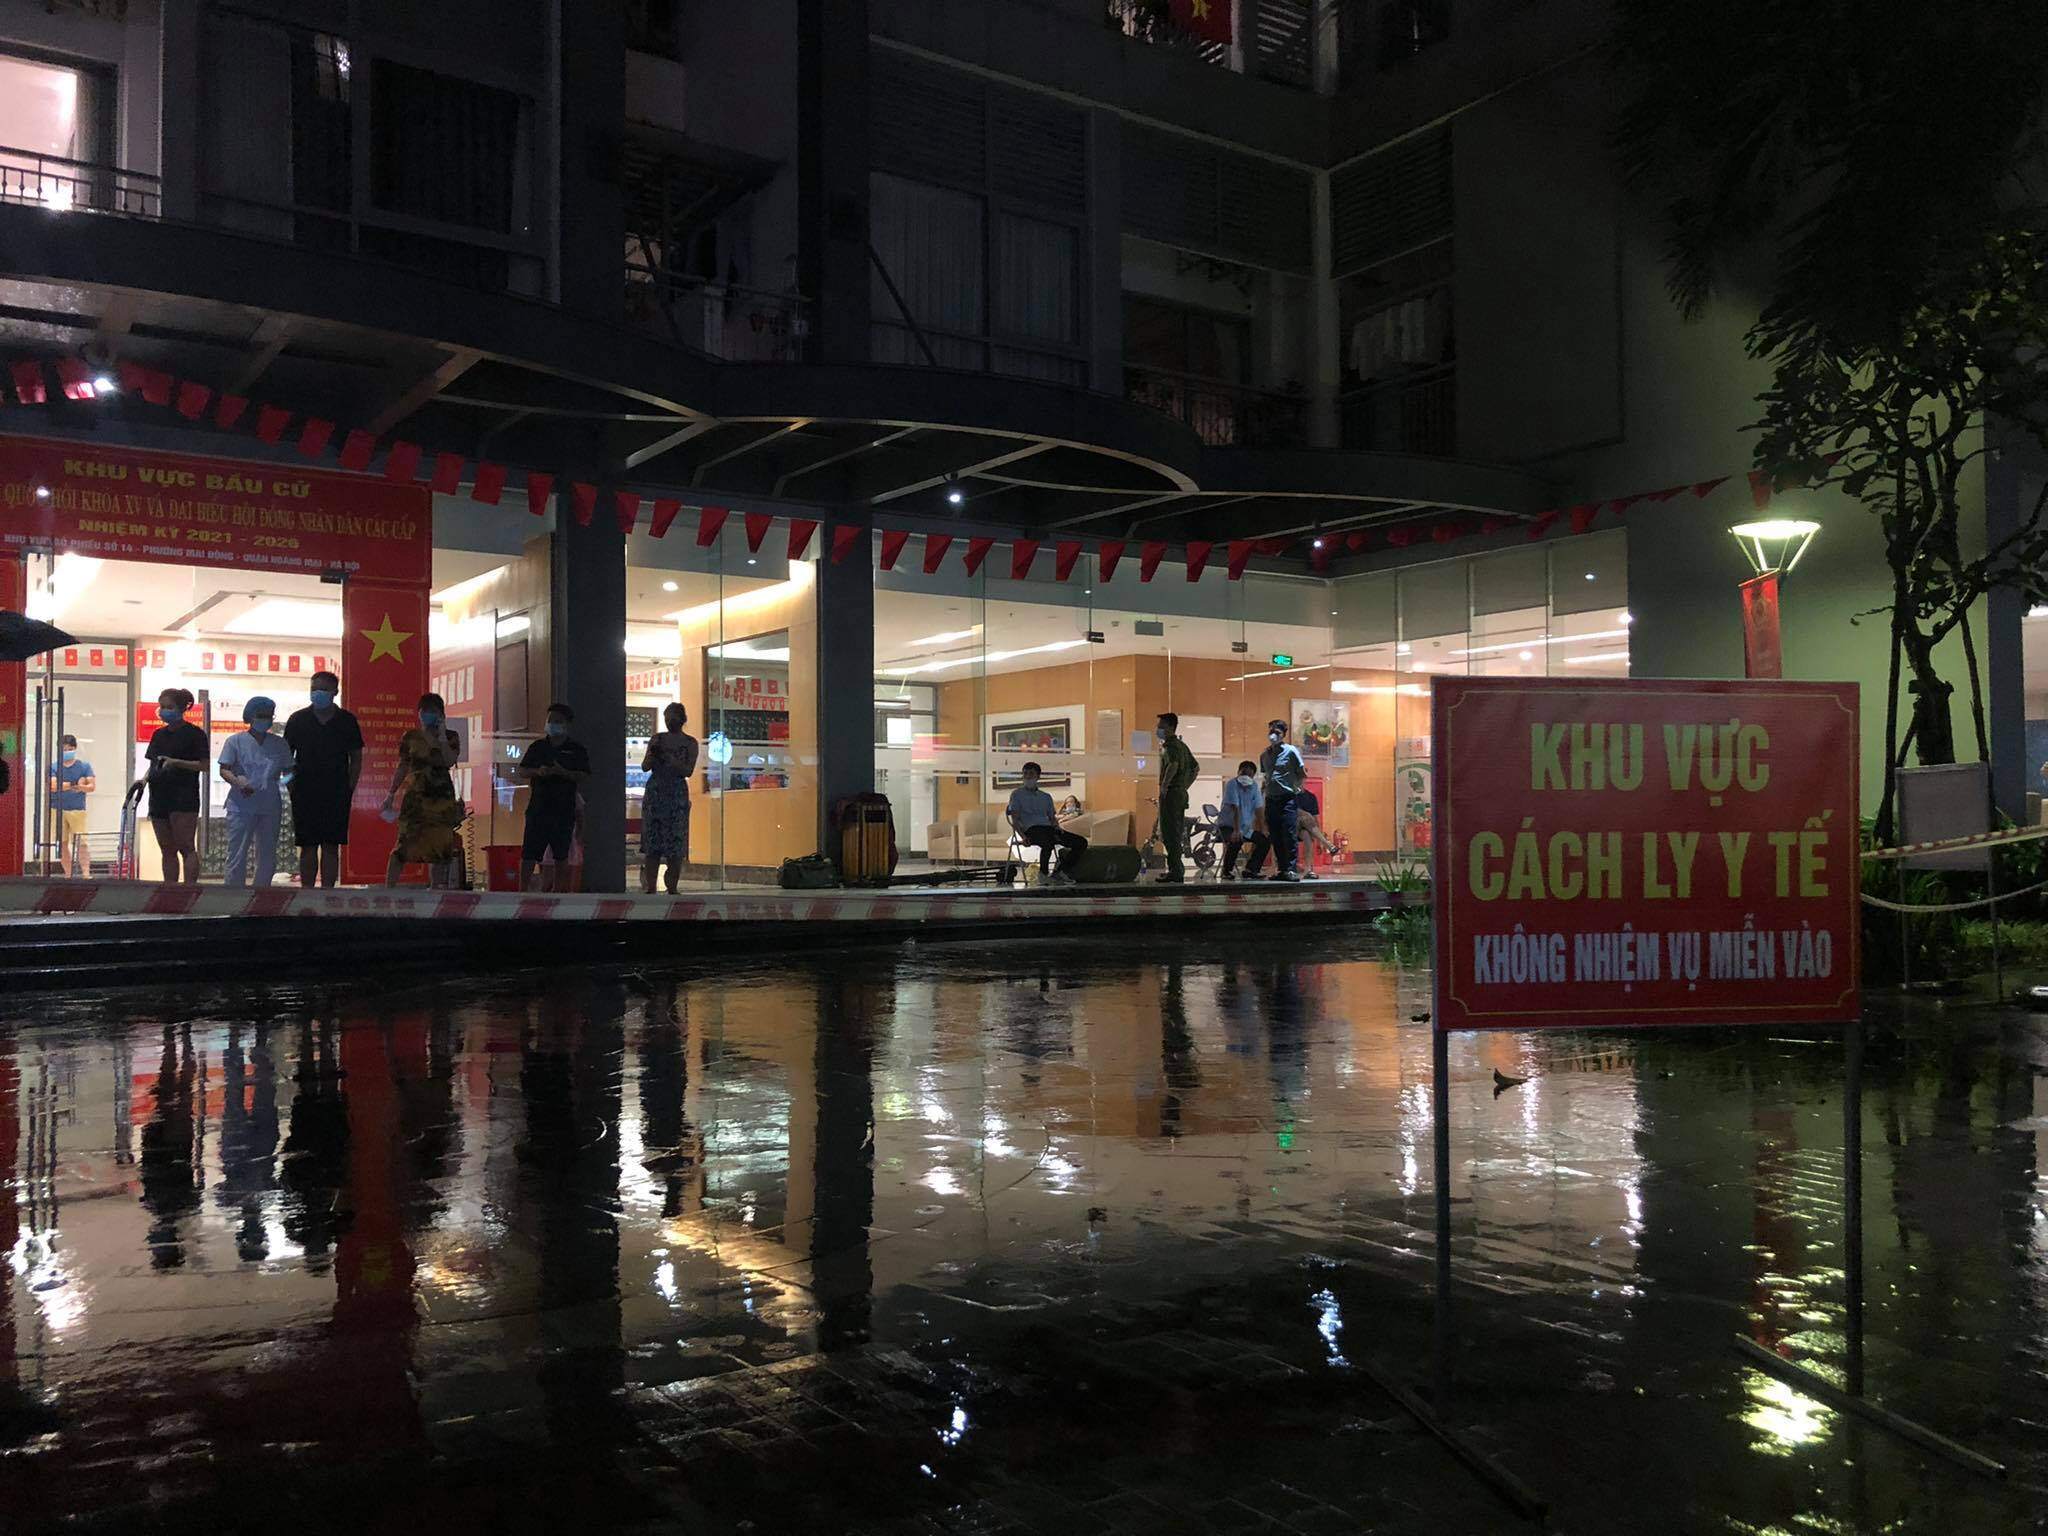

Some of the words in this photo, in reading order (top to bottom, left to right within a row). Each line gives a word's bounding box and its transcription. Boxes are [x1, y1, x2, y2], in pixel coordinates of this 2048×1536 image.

[5, 482, 49, 508] QUỐ
[127, 495, 143, 516] XV
[64, 459, 128, 480] KHU
[138, 466, 196, 487] VỰC
[272, 480, 311, 498] CỬ
[79, 519, 147, 538] NHIỆM
[186, 528, 232, 544] 2021
[254, 534, 300, 549] 2026
[1530, 723, 1644, 791] KHU
[1664, 719, 1770, 807] VỰC
[1468, 817, 1622, 901] CÁCH
[1641, 831, 1700, 899] LY
[1718, 831, 1751, 899] Y
[1768, 808, 1833, 898] TẾ
[1473, 923, 1567, 984] KHÔNG
[1574, 922, 1660, 992] NHIỆM
[1667, 934, 1701, 991] VỤ
[1709, 912, 1775, 980] MIỄN
[1782, 919, 1832, 979] VÀO
